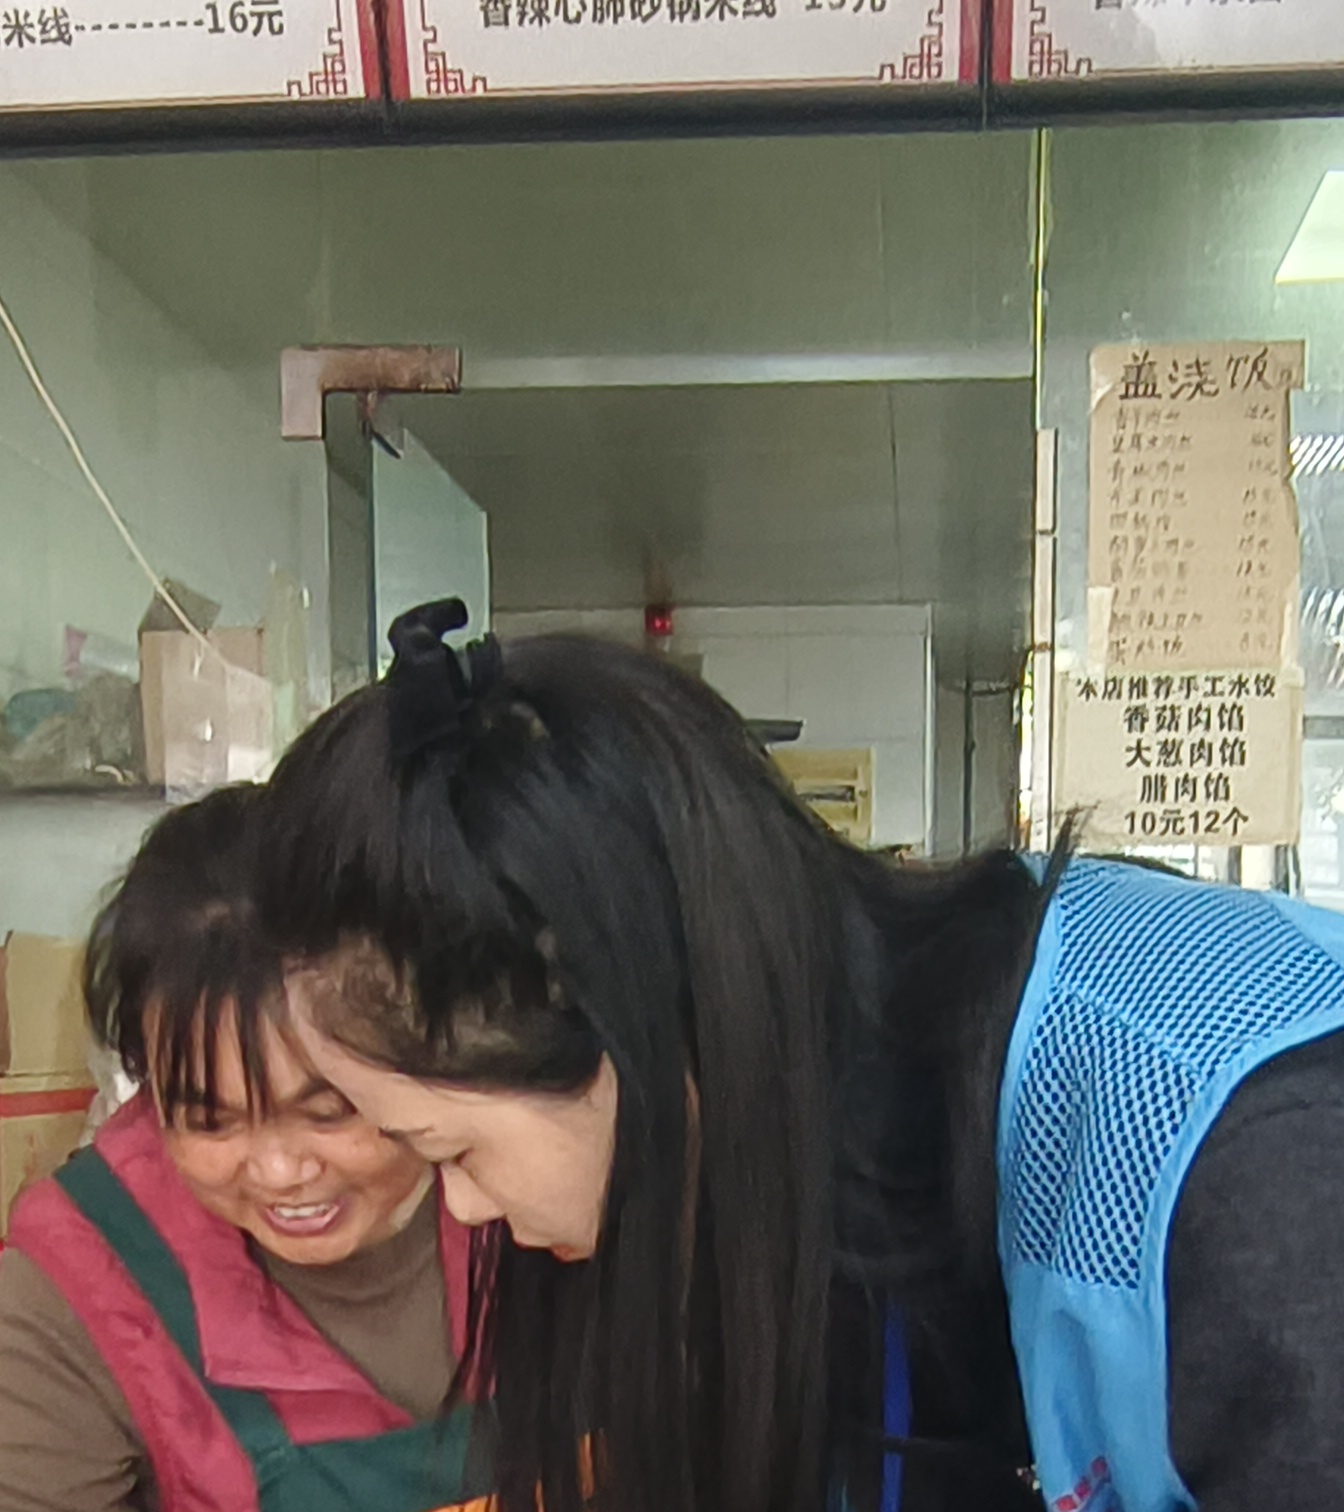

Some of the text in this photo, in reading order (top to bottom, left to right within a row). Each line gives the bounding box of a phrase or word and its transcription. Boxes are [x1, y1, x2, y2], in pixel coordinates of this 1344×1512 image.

[1077, 673, 1276, 701] 本店推荐手工水饺
[1123, 702, 1245, 734] 香菇肉馅
[1125, 736, 1247, 768] 大葱肉馅
[1124, 806, 1249, 837] 10元12个
